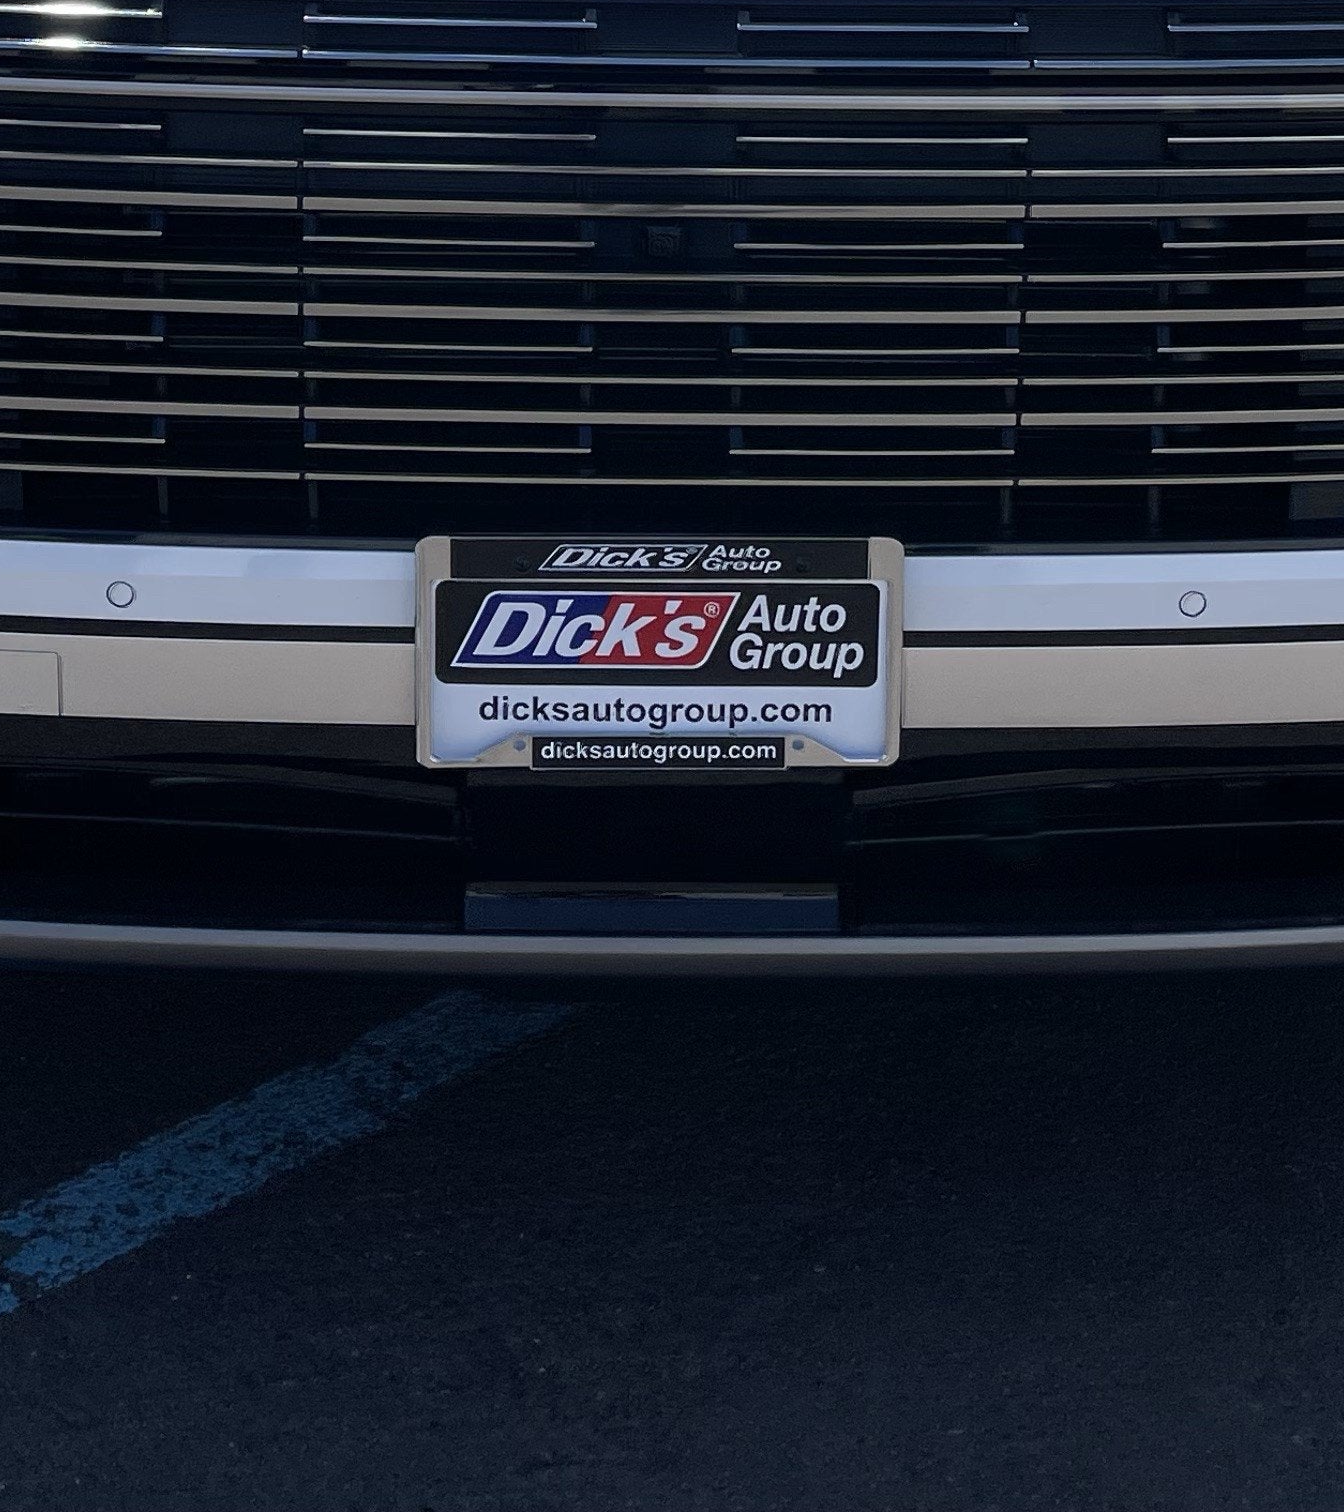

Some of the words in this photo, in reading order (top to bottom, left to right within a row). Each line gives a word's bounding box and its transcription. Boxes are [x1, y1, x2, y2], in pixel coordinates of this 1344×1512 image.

[709, 544, 771, 559] Auto
[702, 558, 782, 574] Group
[737, 595, 847, 633] Auto
[729, 634, 864, 678] Group
[478, 696, 833, 729] dicksautogroup.com
[541, 741, 777, 763] dicksautogroup.com
